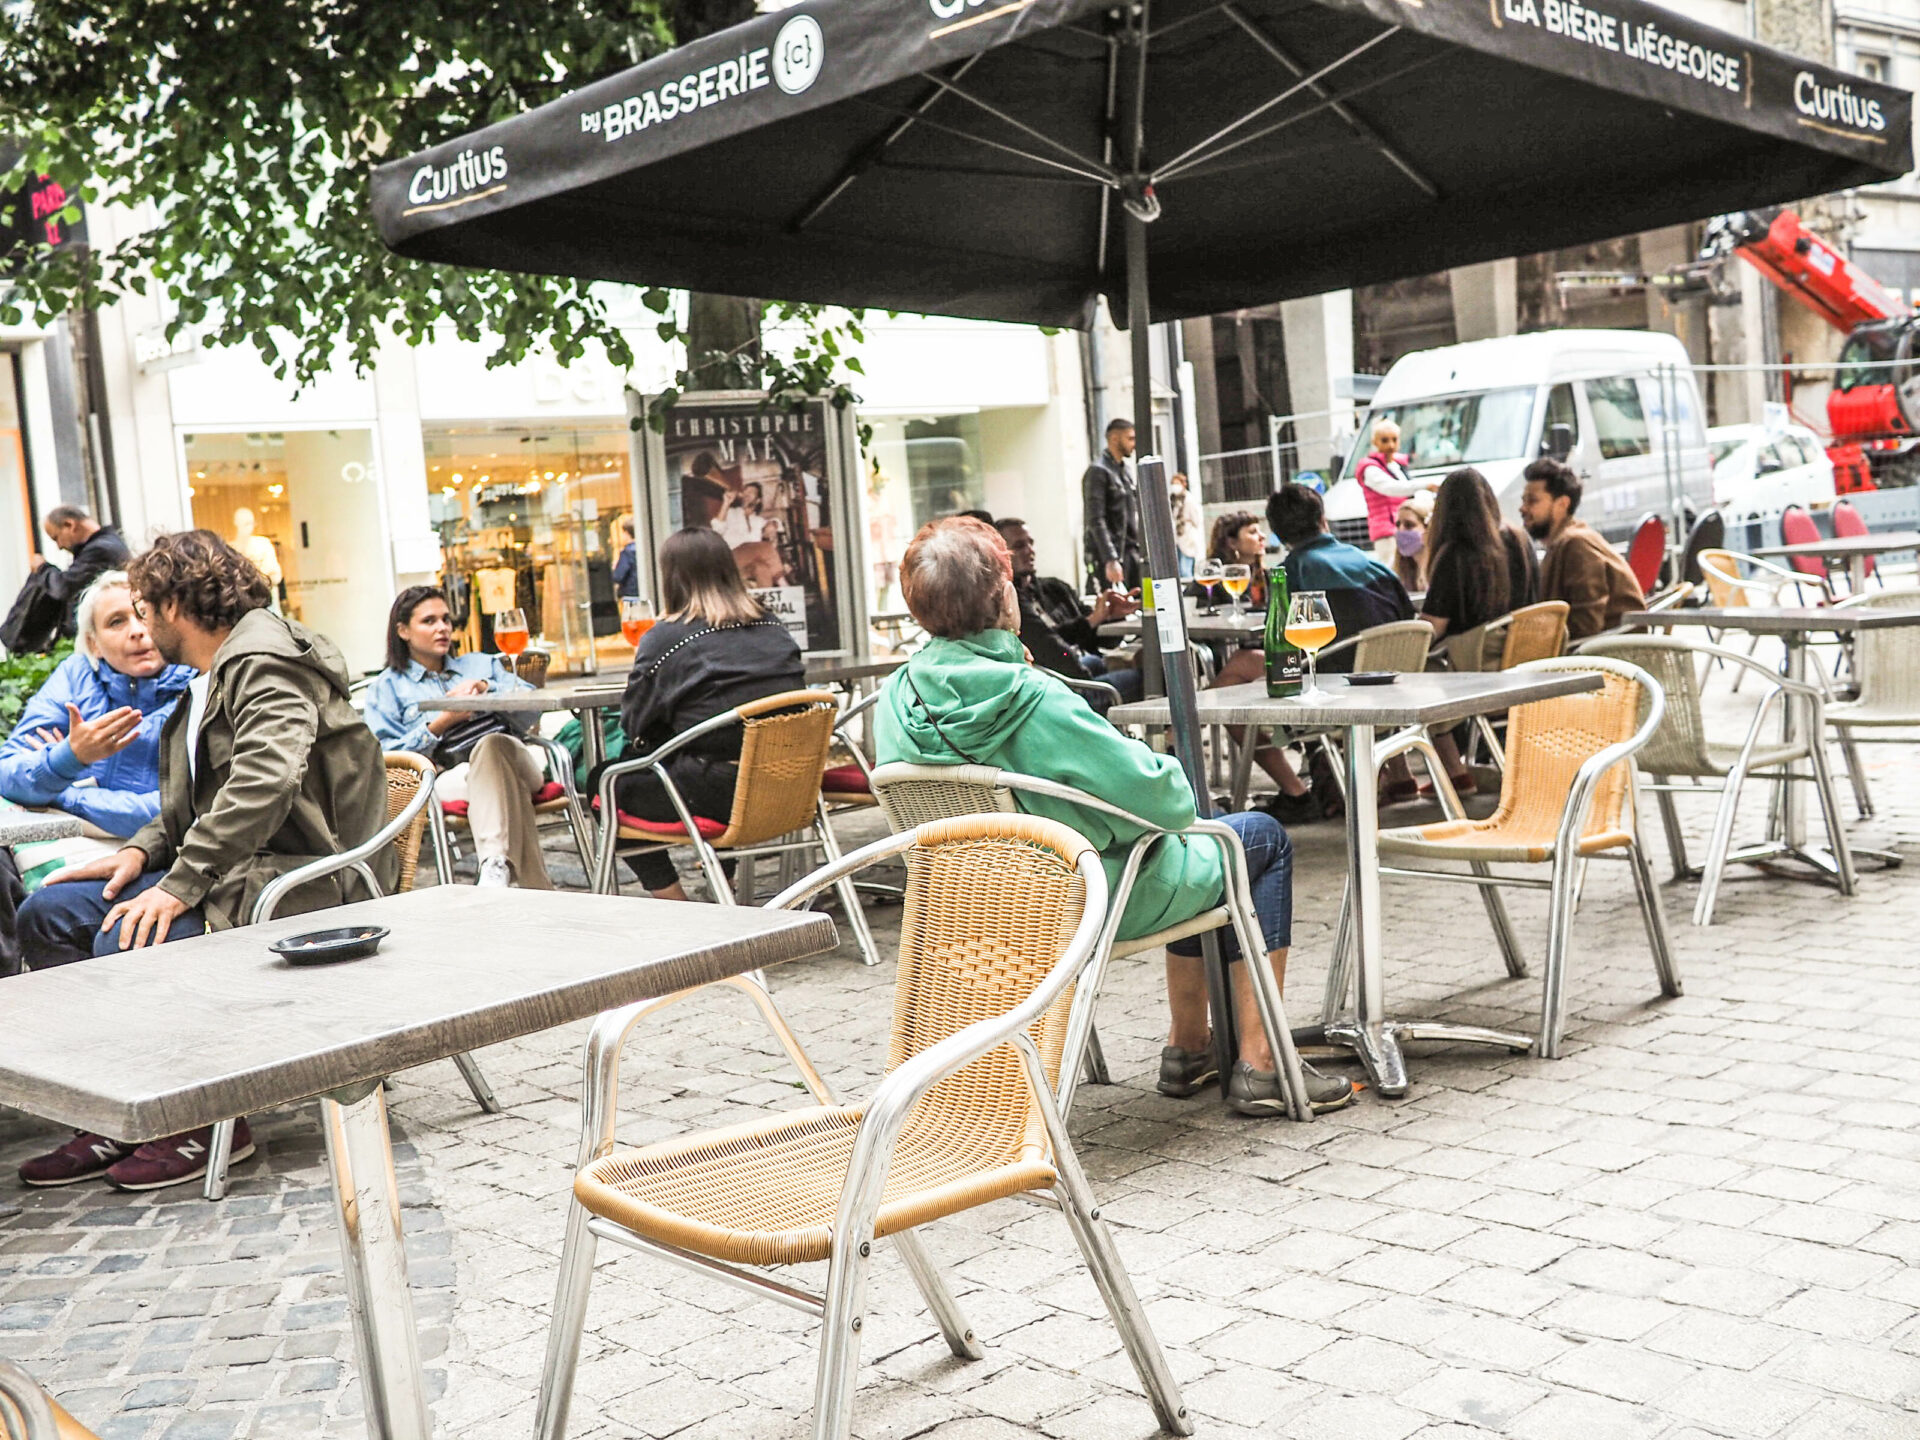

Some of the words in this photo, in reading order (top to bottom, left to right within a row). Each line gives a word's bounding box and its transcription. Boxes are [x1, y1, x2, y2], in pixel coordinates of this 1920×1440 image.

[1543, 0, 1620, 51] BIÈRE
[1622, 22, 1740, 92] LIÉGEOISE
[580, 111, 602, 134] by
[602, 47, 770, 142] BRASSERIE
[1794, 71, 1886, 131] Curtius
[408, 145, 508, 204] Curtius
[675, 414, 814, 437] CHRISTOPHE
[718, 434, 776, 462] MAÉ
